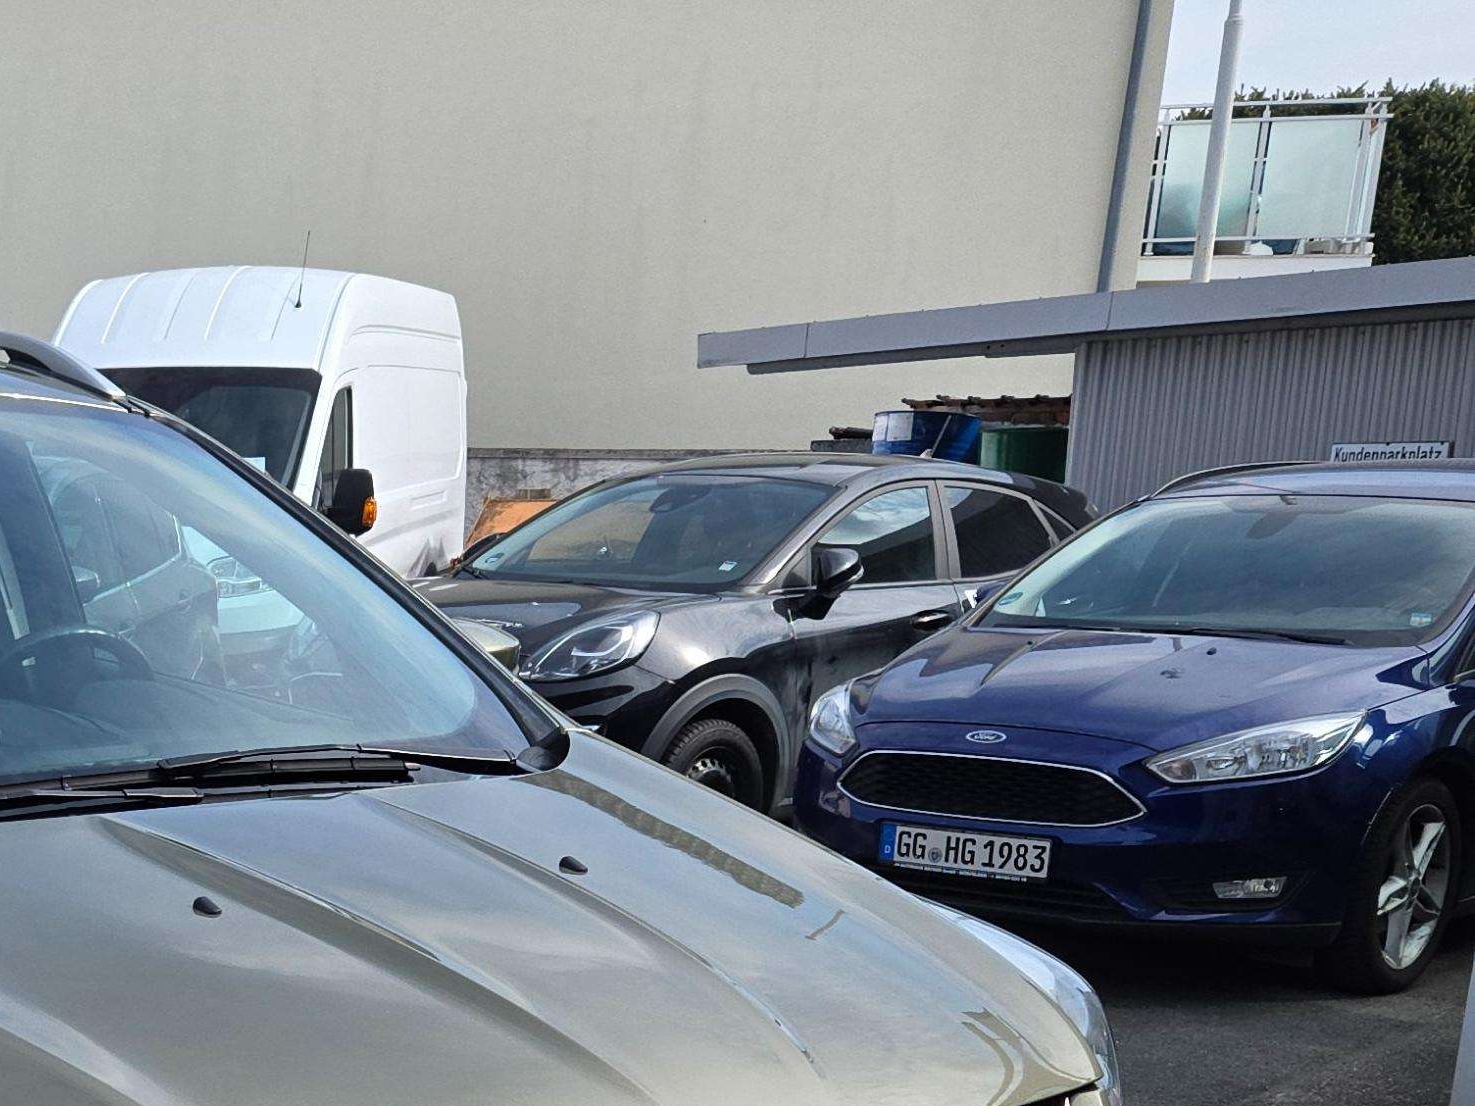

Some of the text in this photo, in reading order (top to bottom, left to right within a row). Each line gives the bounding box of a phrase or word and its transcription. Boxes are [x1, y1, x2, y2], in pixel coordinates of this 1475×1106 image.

[897, 831, 927, 860] GG
[944, 835, 976, 866] HG
[981, 840, 1047, 874] 1983
